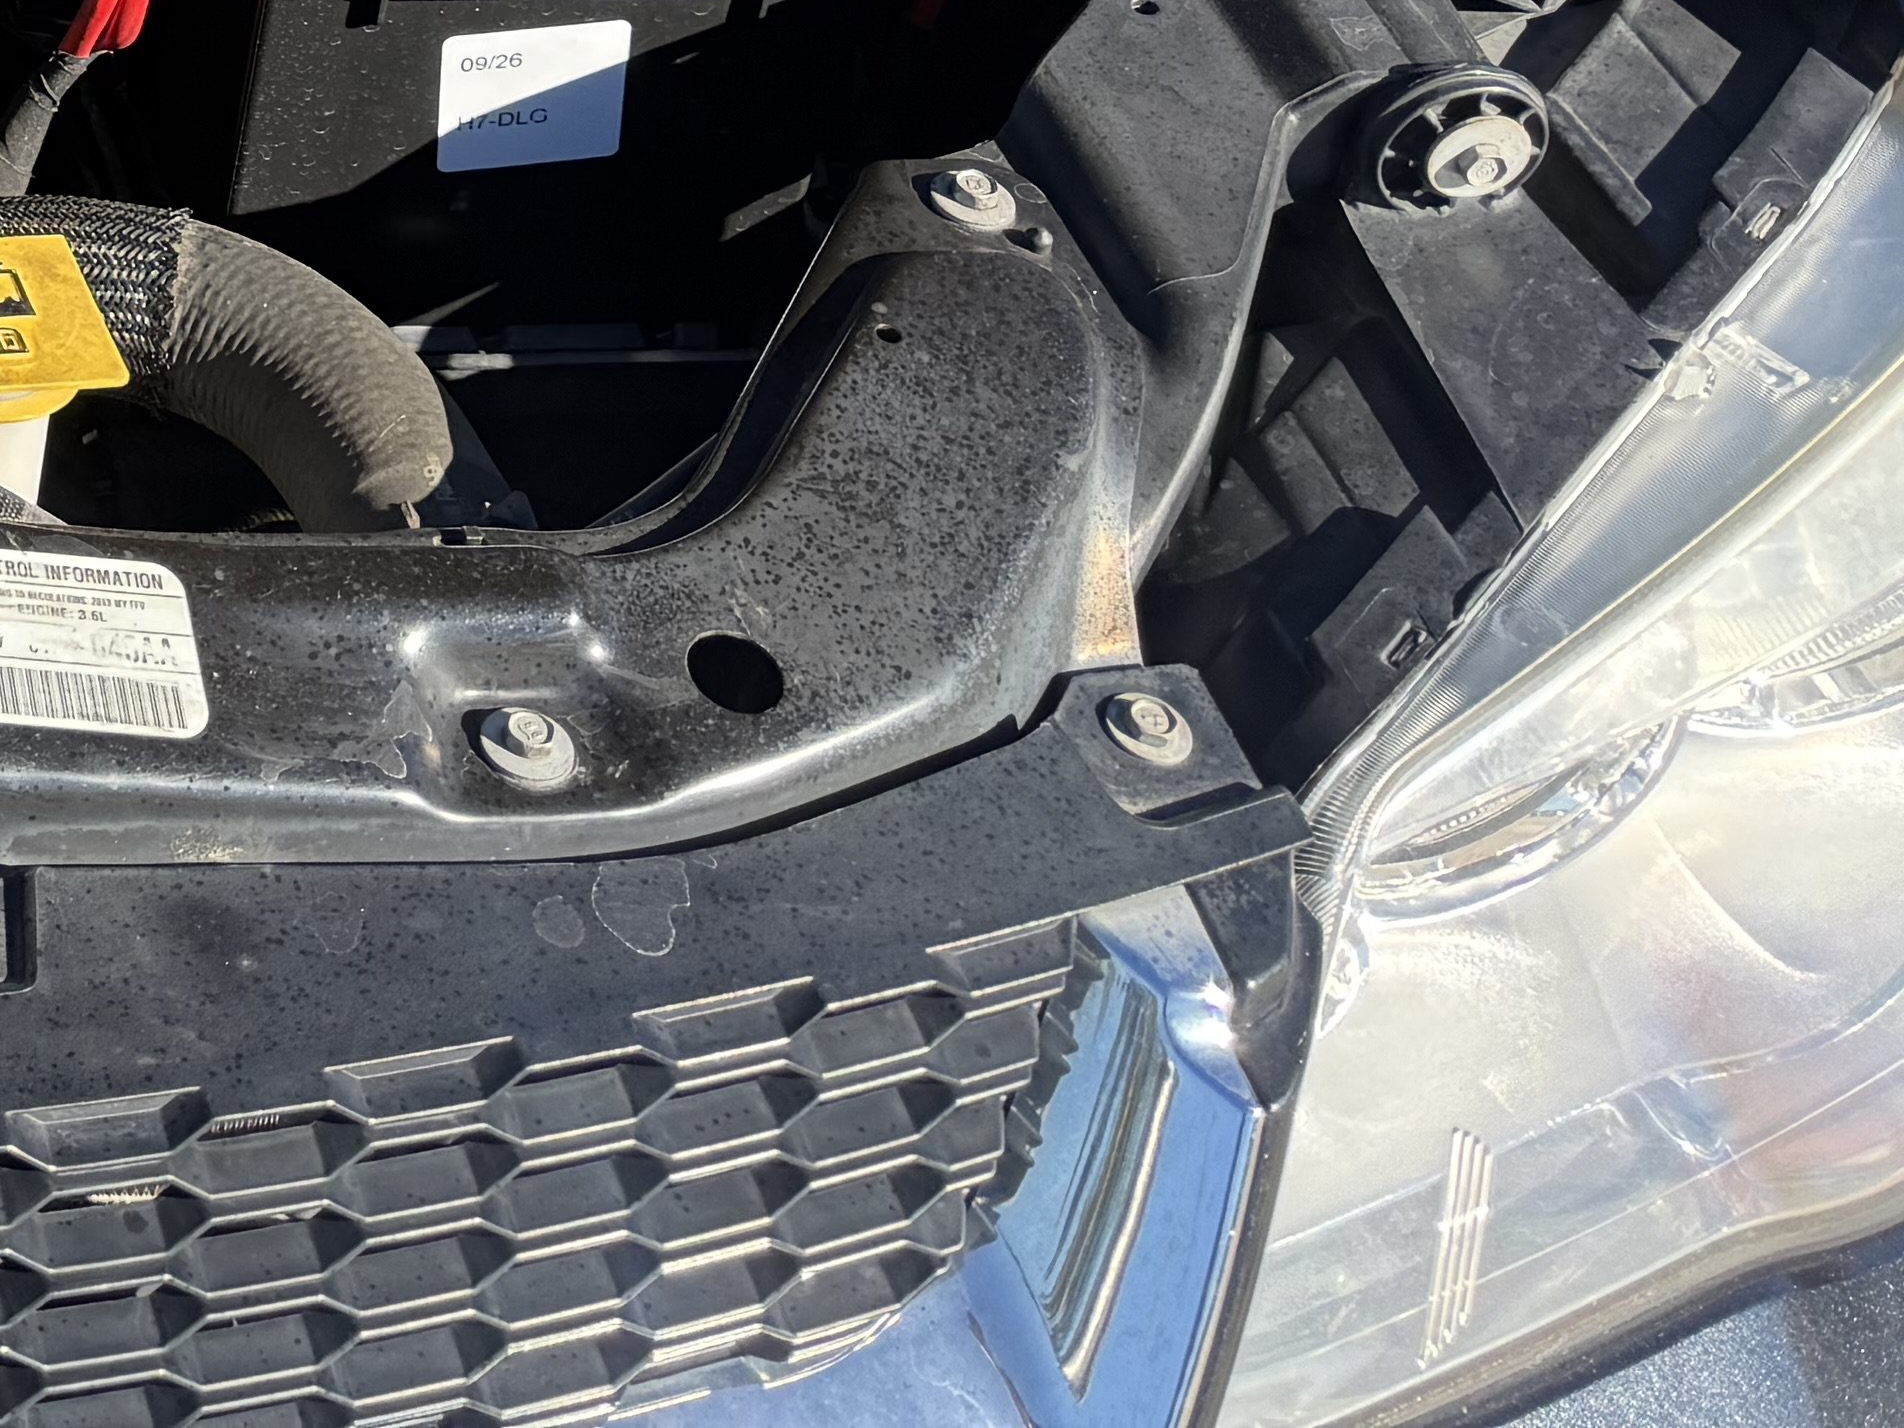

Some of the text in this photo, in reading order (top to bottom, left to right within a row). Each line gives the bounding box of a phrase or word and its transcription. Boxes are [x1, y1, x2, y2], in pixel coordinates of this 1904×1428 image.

[460, 52, 524, 73] 09/26
[456, 107, 549, 132] H7-DLG
[44, 564, 165, 590] INFORMATION
[17, 603, 108, 622] ENGINE: 3.6L
